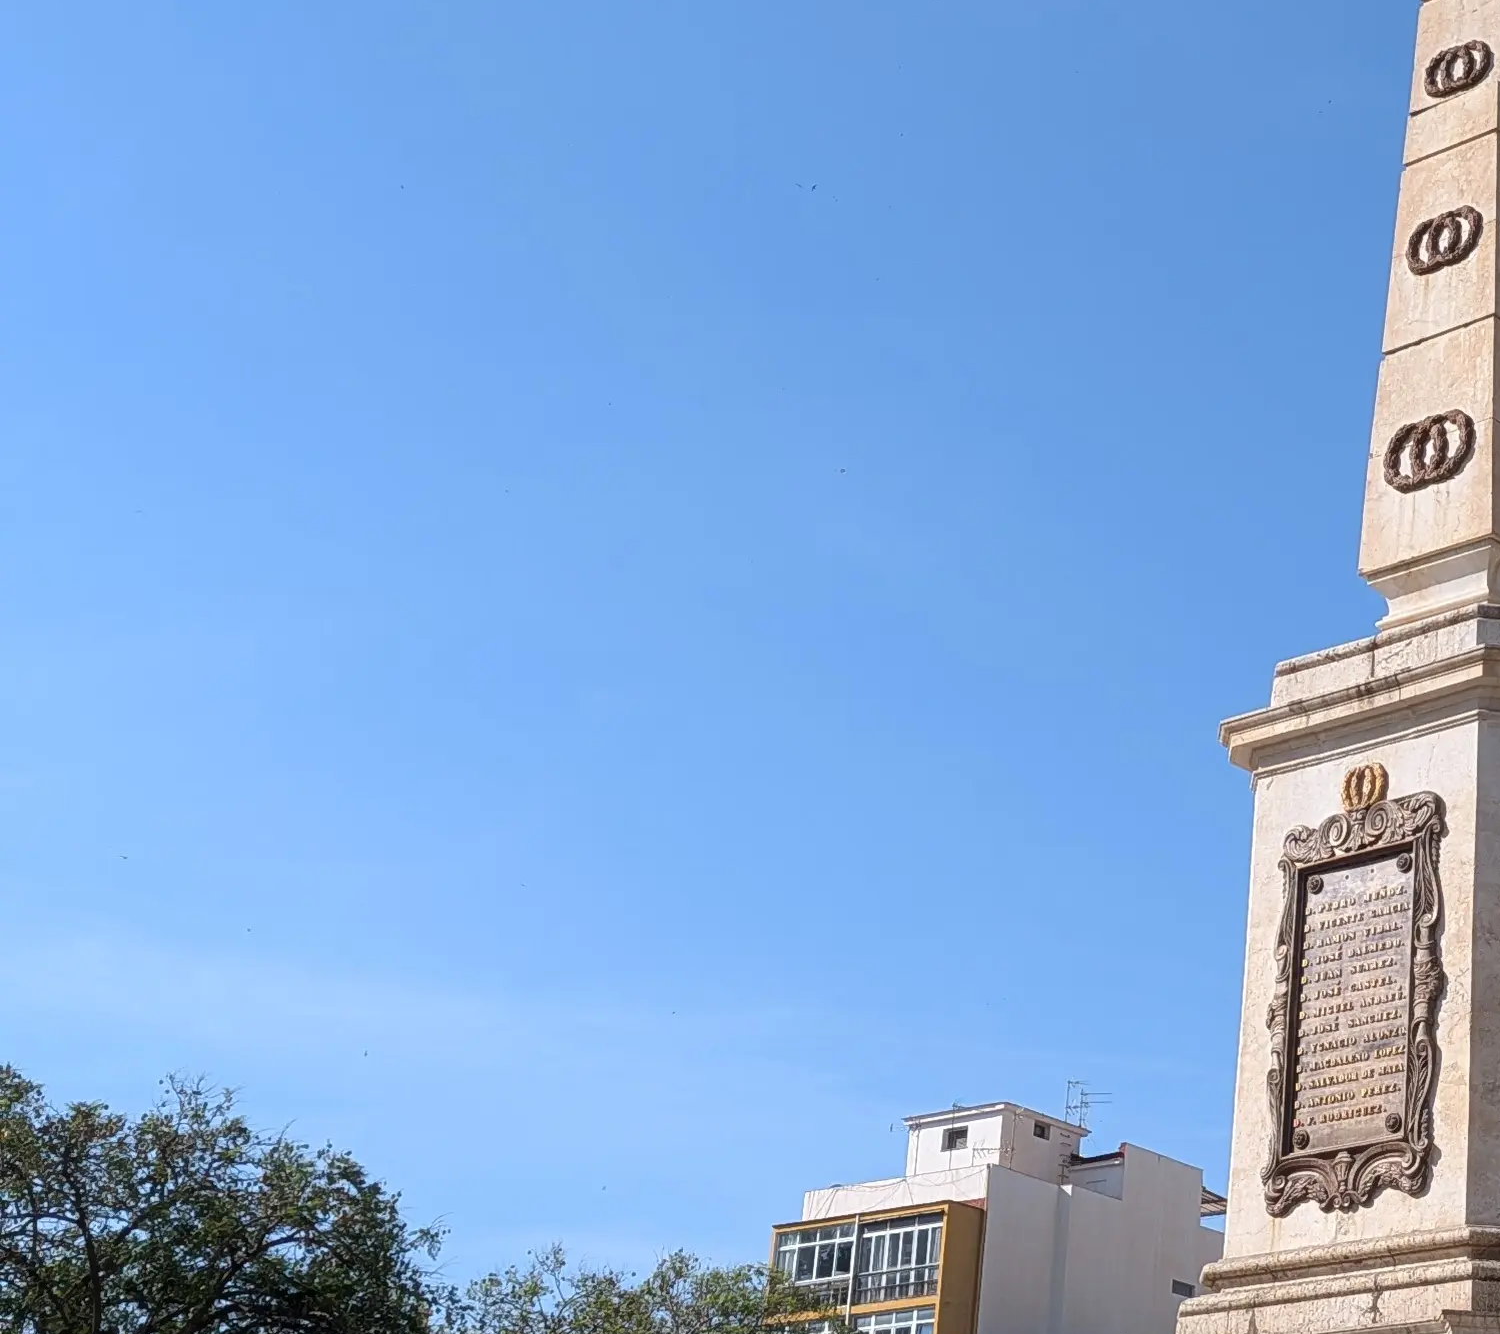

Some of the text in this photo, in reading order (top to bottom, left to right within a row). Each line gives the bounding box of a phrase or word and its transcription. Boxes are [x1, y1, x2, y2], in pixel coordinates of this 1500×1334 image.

[1318, 897, 1356, 913] PEDRO
[1319, 913, 1365, 931] VICENTE
[1316, 931, 1356, 948] RAMON
[1314, 968, 1342, 983] JUAN
[1312, 1001, 1354, 1018] MIGUEL
[1308, 1071, 1359, 1090] SALVADOR
[1361, 1068, 1375, 1080] DE
[1308, 1090, 1356, 1108] ANTONIO
[1319, 1105, 1387, 1124] RODRIGUEZ.
